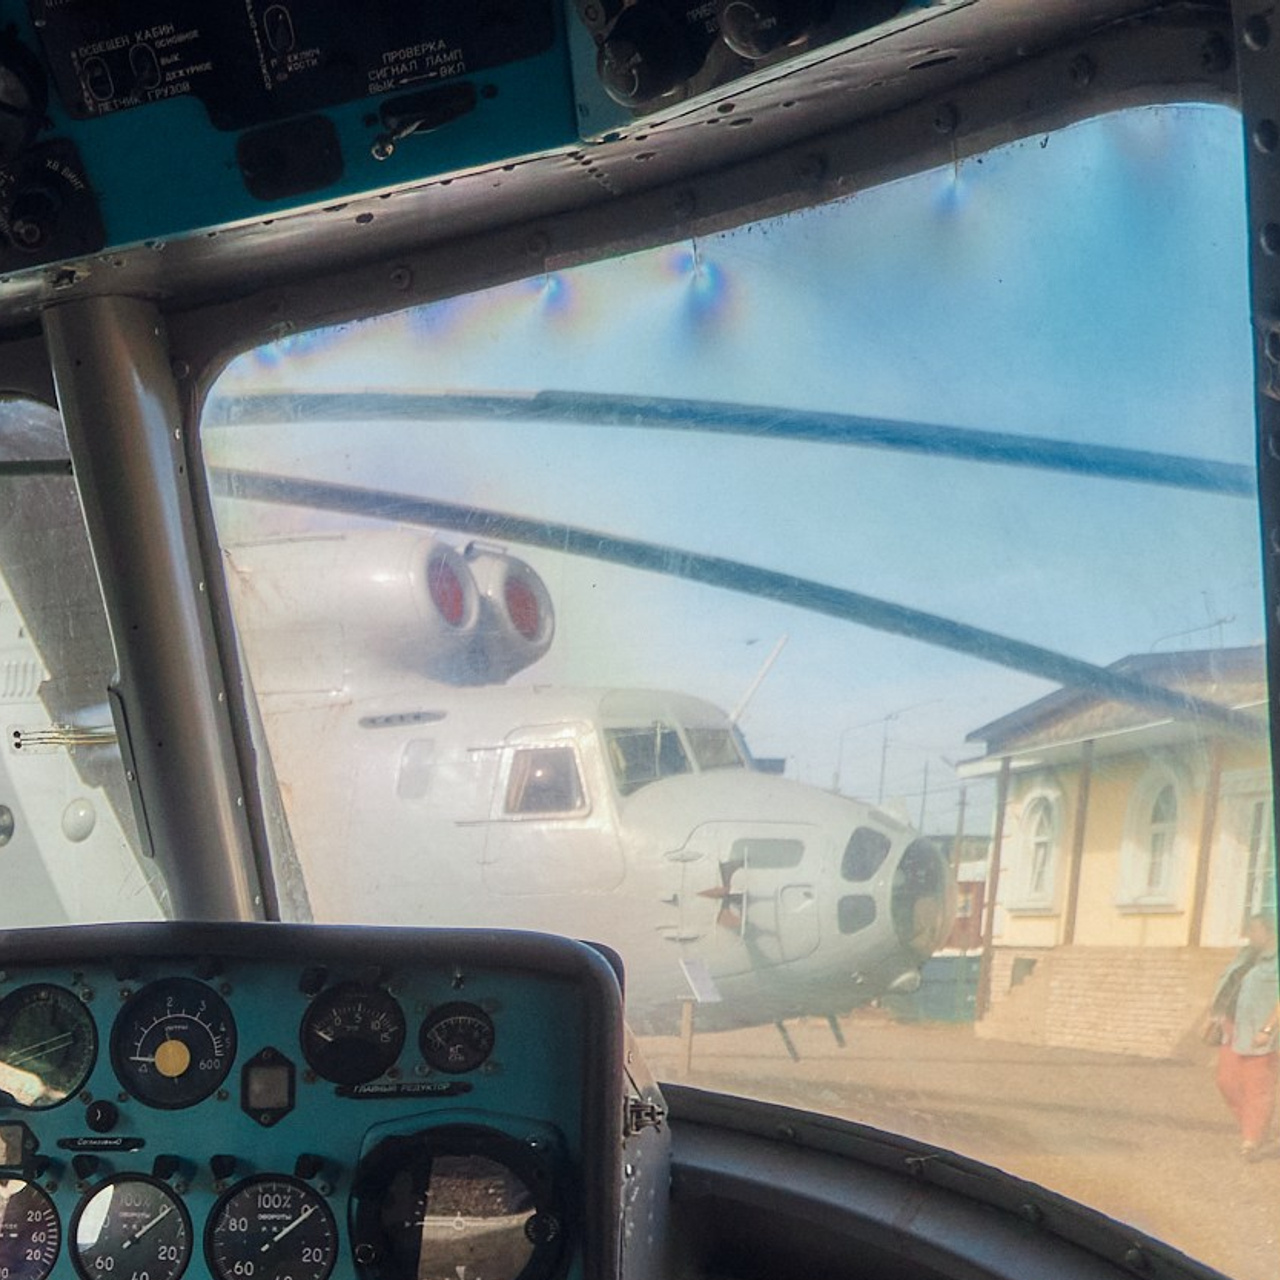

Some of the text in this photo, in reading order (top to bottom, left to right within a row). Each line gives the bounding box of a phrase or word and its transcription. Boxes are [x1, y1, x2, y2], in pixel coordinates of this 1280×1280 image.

[382, 39, 448, 64] ПРОВЕРКА
[368, 48, 463, 81] СИГНАЛ ЛАМП
[439, 61, 466, 78] ВКЛ
[166, 997, 174, 1008] 2
[200, 1001, 207, 1012] 3
[199, 1059, 221, 1070] 600
[400, 1083, 450, 1093] РЕДУКТОР
[257, 1194, 292, 1208] 100%
[27, 1210, 42, 1222] 20
[228, 1217, 248, 1232] 80
[31, 1232, 46, 1243] 60
[26, 1249, 41, 1261] 20
[158, 1246, 177, 1261] 20
[302, 1248, 322, 1263] 20
[95, 1256, 114, 1271] 60
[234, 1261, 254, 1276] 60
